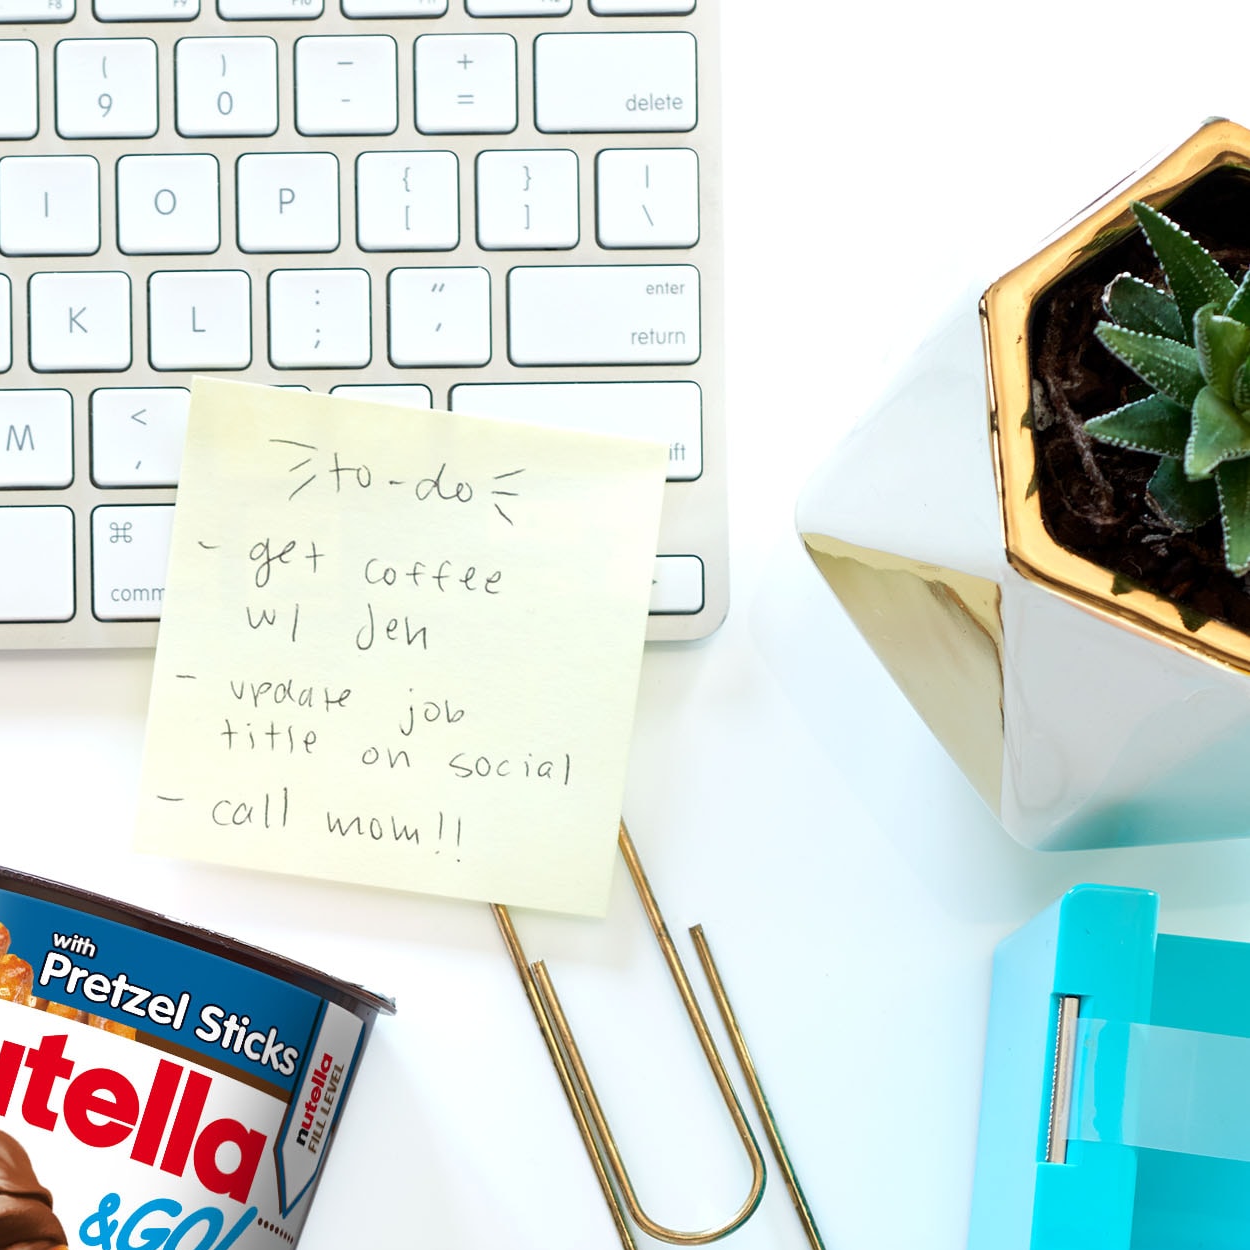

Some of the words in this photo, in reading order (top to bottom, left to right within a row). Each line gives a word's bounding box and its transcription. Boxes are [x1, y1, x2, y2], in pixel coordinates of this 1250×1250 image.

[97, 92, 113, 118] 9
[216, 90, 234, 116] 0
[625, 93, 684, 112] delete
[153, 188, 177, 216] O
[278, 187, 296, 215] P
[645, 282, 685, 295] enter
[68, 306, 89, 334] K
[191, 305, 207, 333] L
[631, 328, 686, 345] return
[5, 424, 36, 452] M
[668, 442, 686, 461] ift
[249, 539, 325, 588] get
[111, 588, 166, 602] comm
[230, 676, 353, 713] update
[399, 688, 465, 737] job
[221, 719, 318, 756] title
[361, 744, 411, 769] on
[449, 752, 572, 786] social
[211, 787, 289, 829] call
[326, 809, 463, 863] mom!!
[52, 931, 97, 958] with
[39, 952, 189, 1029] Pretzel
[196, 1007, 299, 1077] Sticks
[296, 1052, 333, 1147] nutella
[308, 1120, 326, 1155] FILL
[320, 1063, 345, 1116] LEVEL
